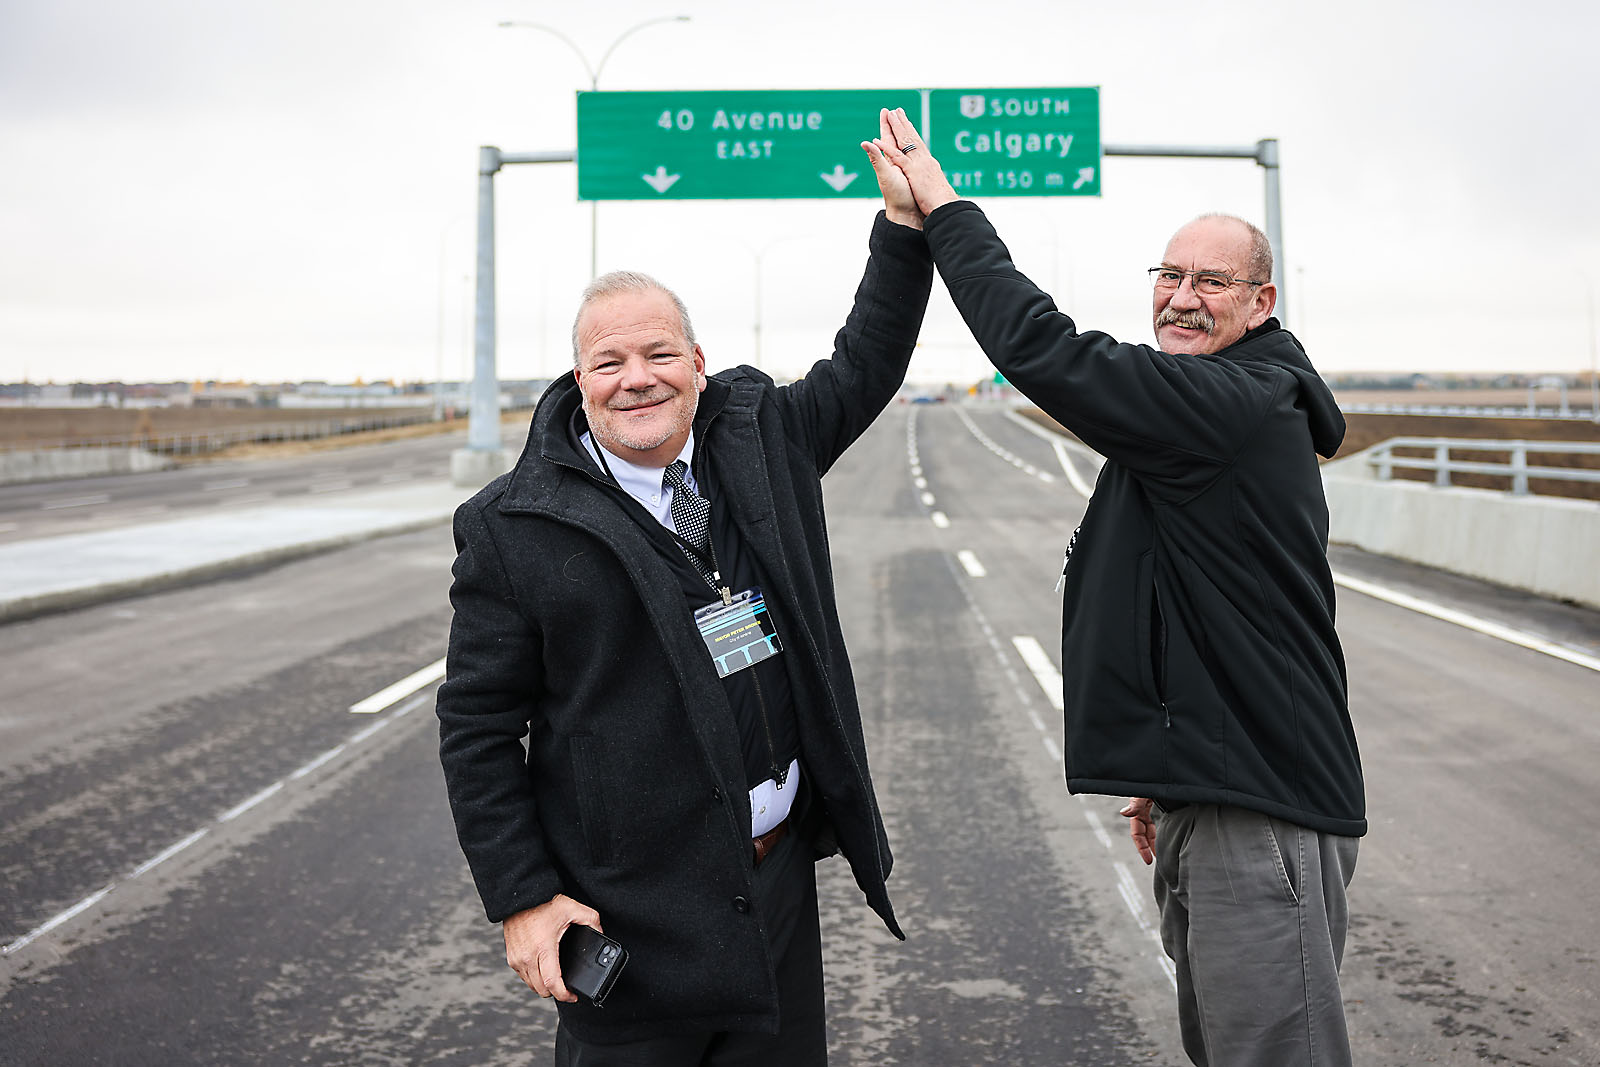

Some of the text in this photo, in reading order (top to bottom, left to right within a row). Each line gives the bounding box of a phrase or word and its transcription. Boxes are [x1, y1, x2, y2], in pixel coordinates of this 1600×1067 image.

[991, 98, 1070, 116] SOUTH
[658, 109, 822, 131] 40 Avenue
[716, 141, 773, 159] EAST
[955, 131, 1073, 158] Calgary
[944, 170, 1064, 188] XIT 150 m
